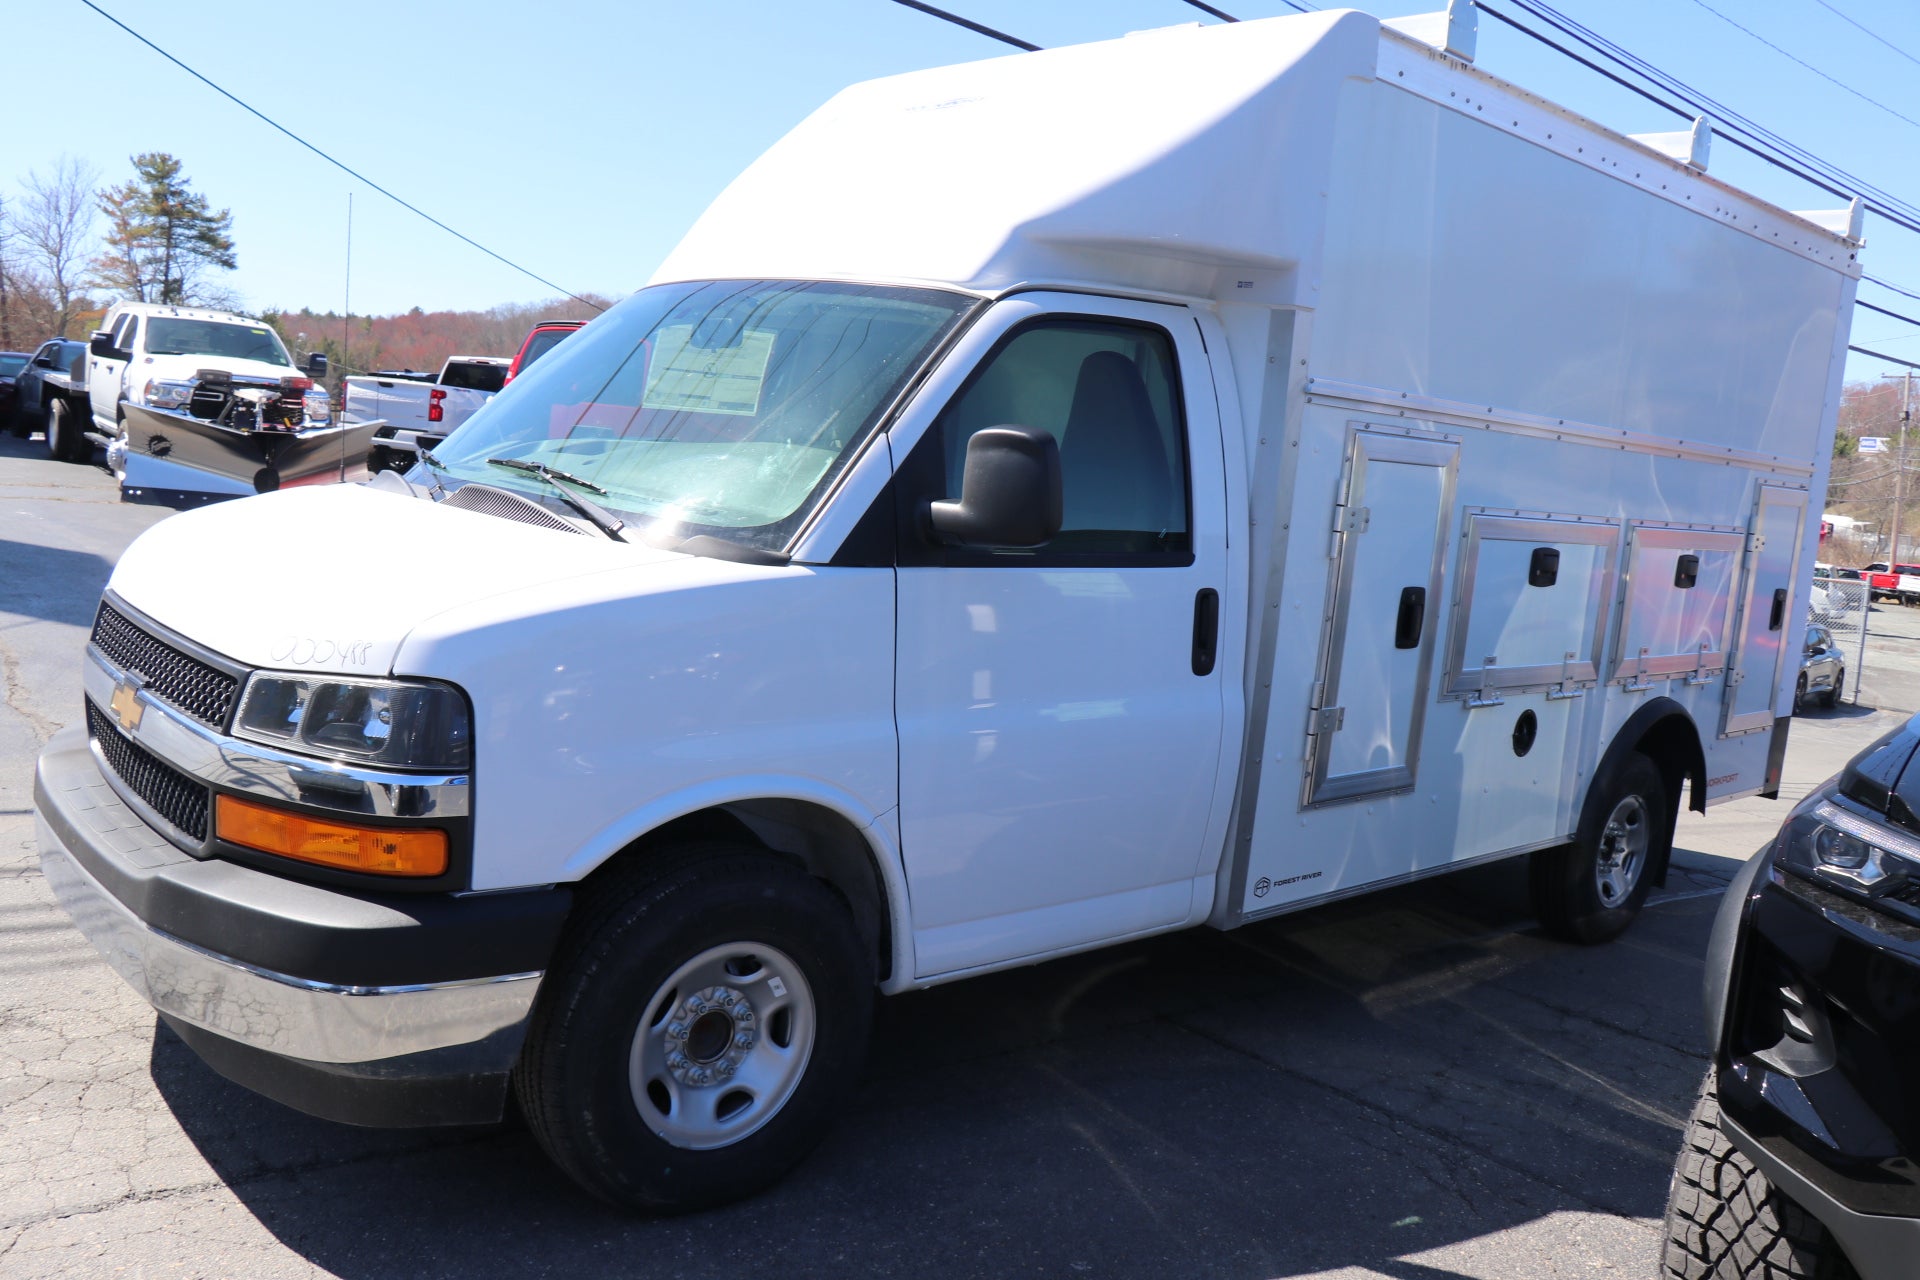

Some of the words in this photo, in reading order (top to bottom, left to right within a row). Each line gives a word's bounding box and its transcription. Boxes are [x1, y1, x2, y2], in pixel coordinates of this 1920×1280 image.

[1706, 773, 1739, 787] ORKPORT
[1273, 876, 1301, 887] FOREST
[1301, 871, 1322, 881] RIVER
